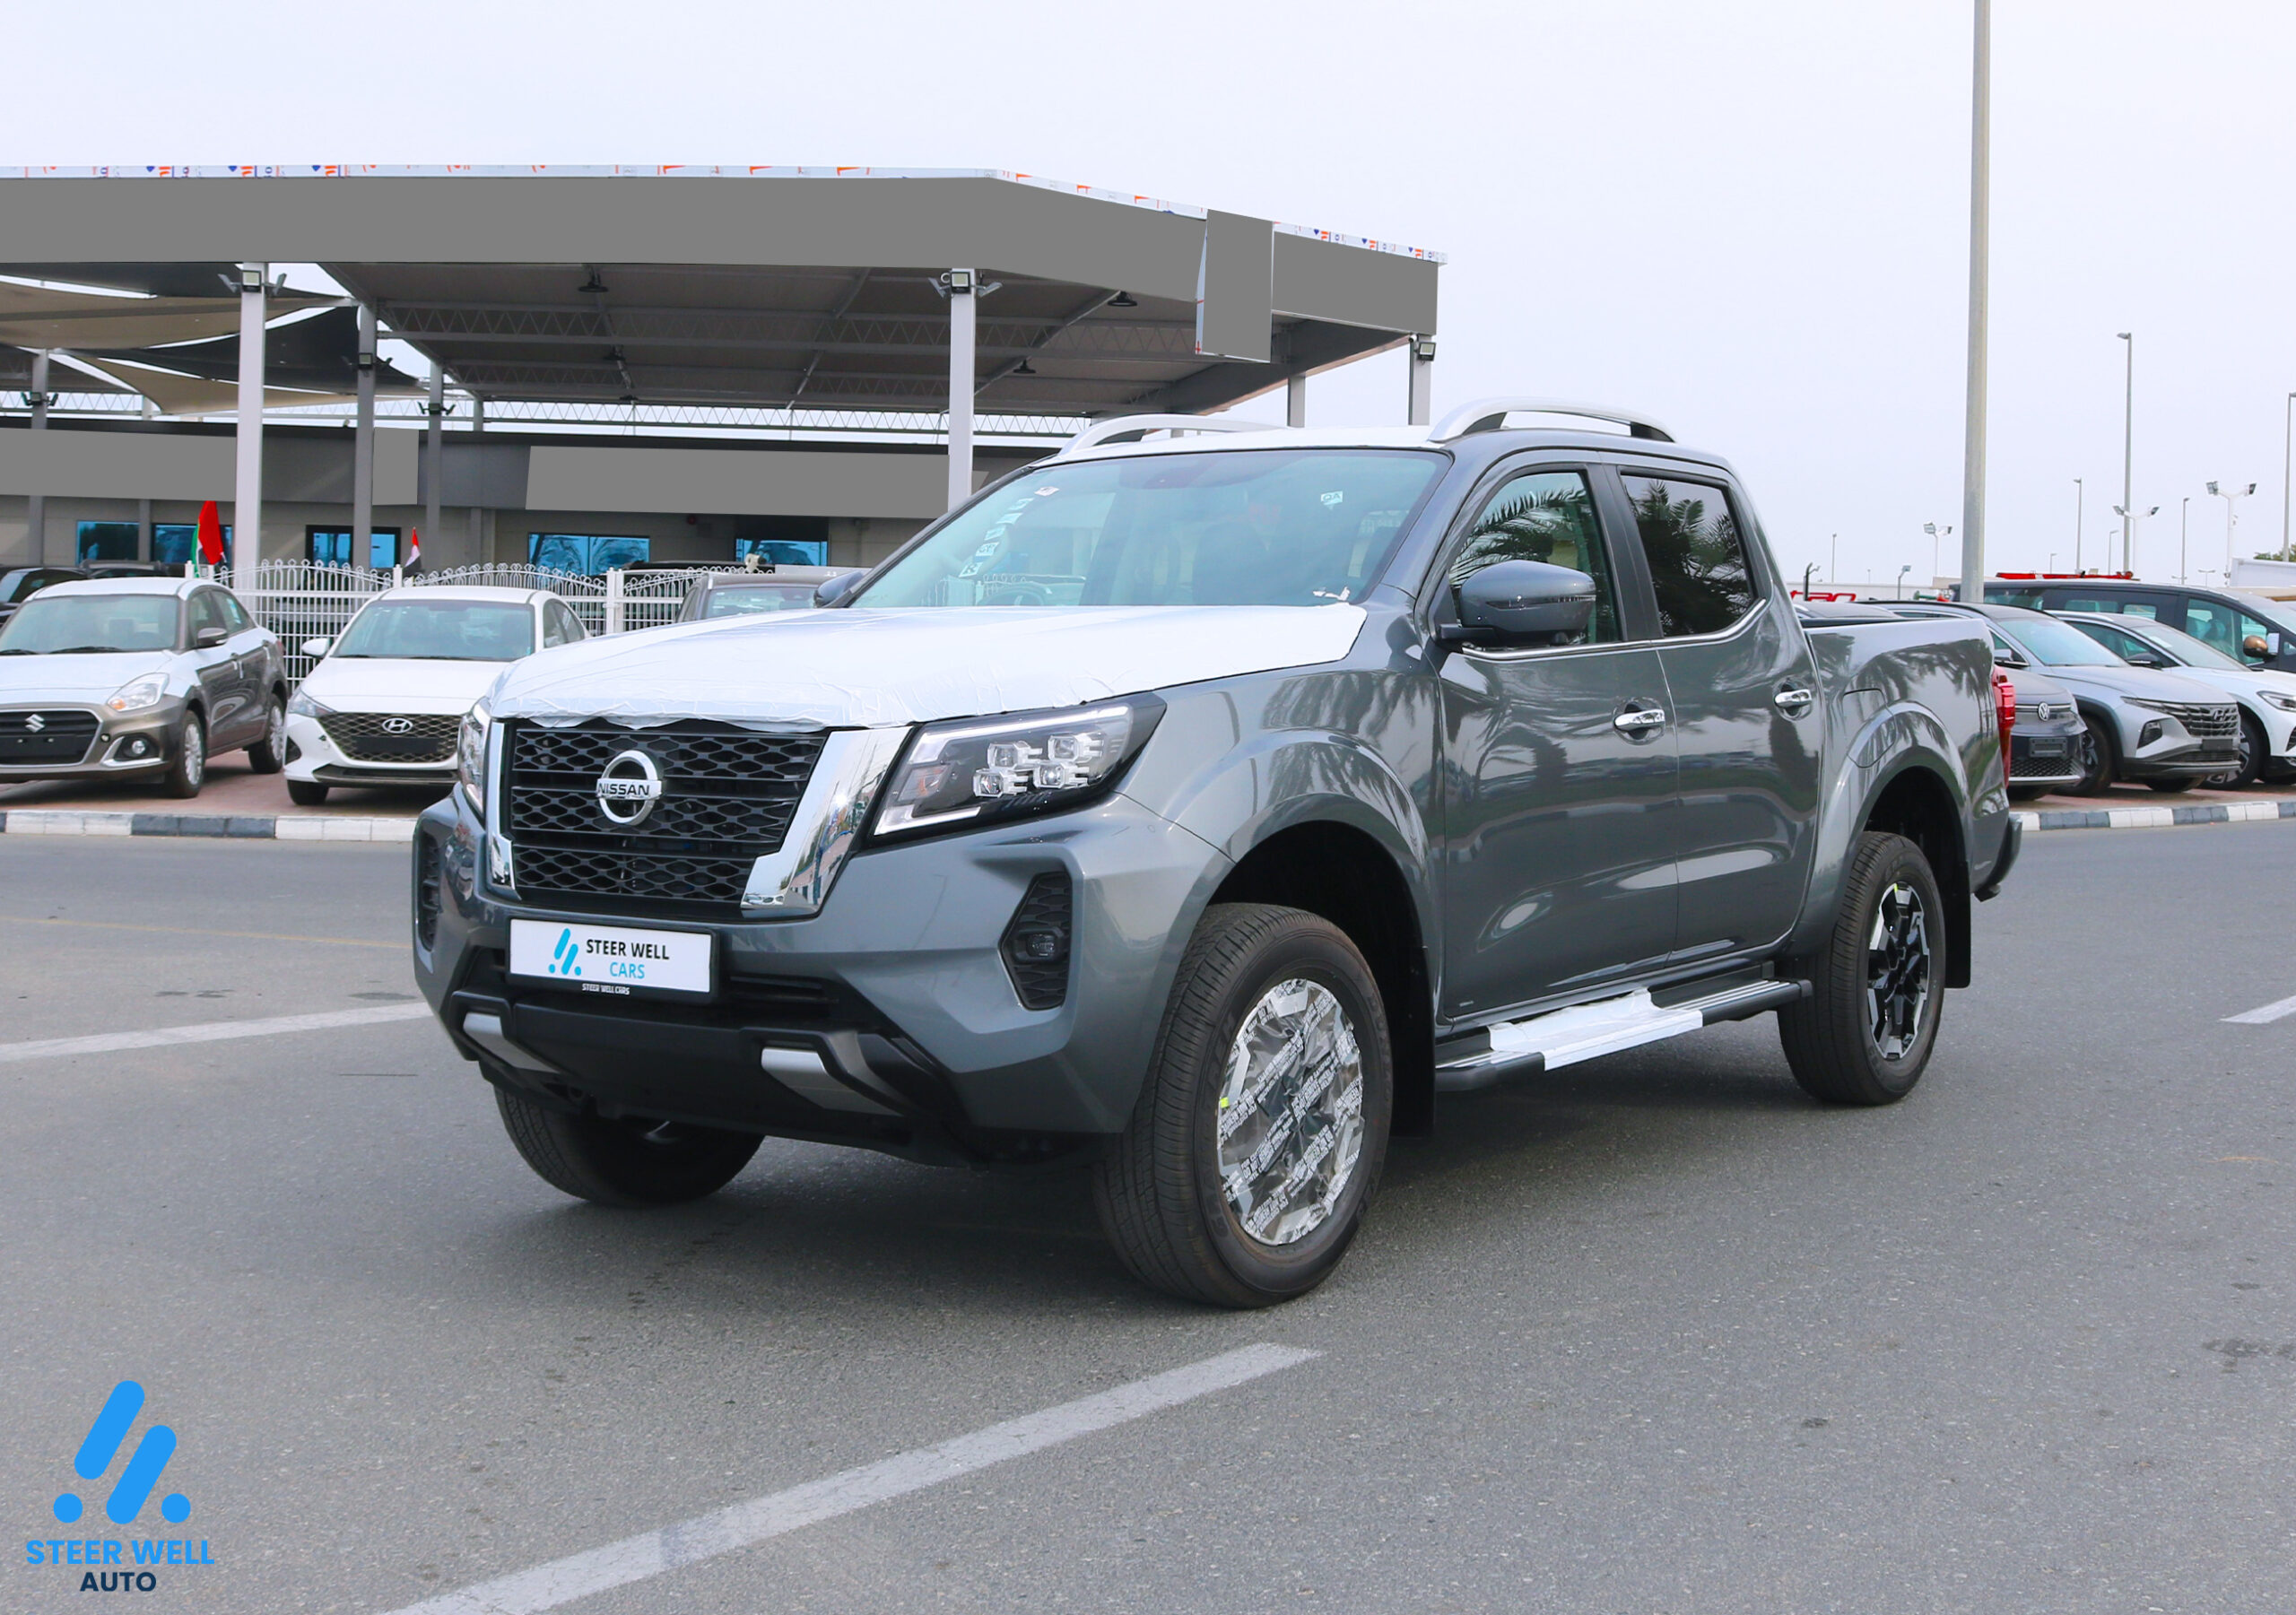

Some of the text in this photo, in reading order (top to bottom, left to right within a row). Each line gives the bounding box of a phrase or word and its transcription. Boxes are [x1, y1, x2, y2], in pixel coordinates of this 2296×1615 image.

[597, 783, 650, 796] NISSAN
[586, 939, 670, 960] STEER WELL
[610, 961, 645, 979] CARS
[581, 983, 631, 995] STEER WELL CARS
